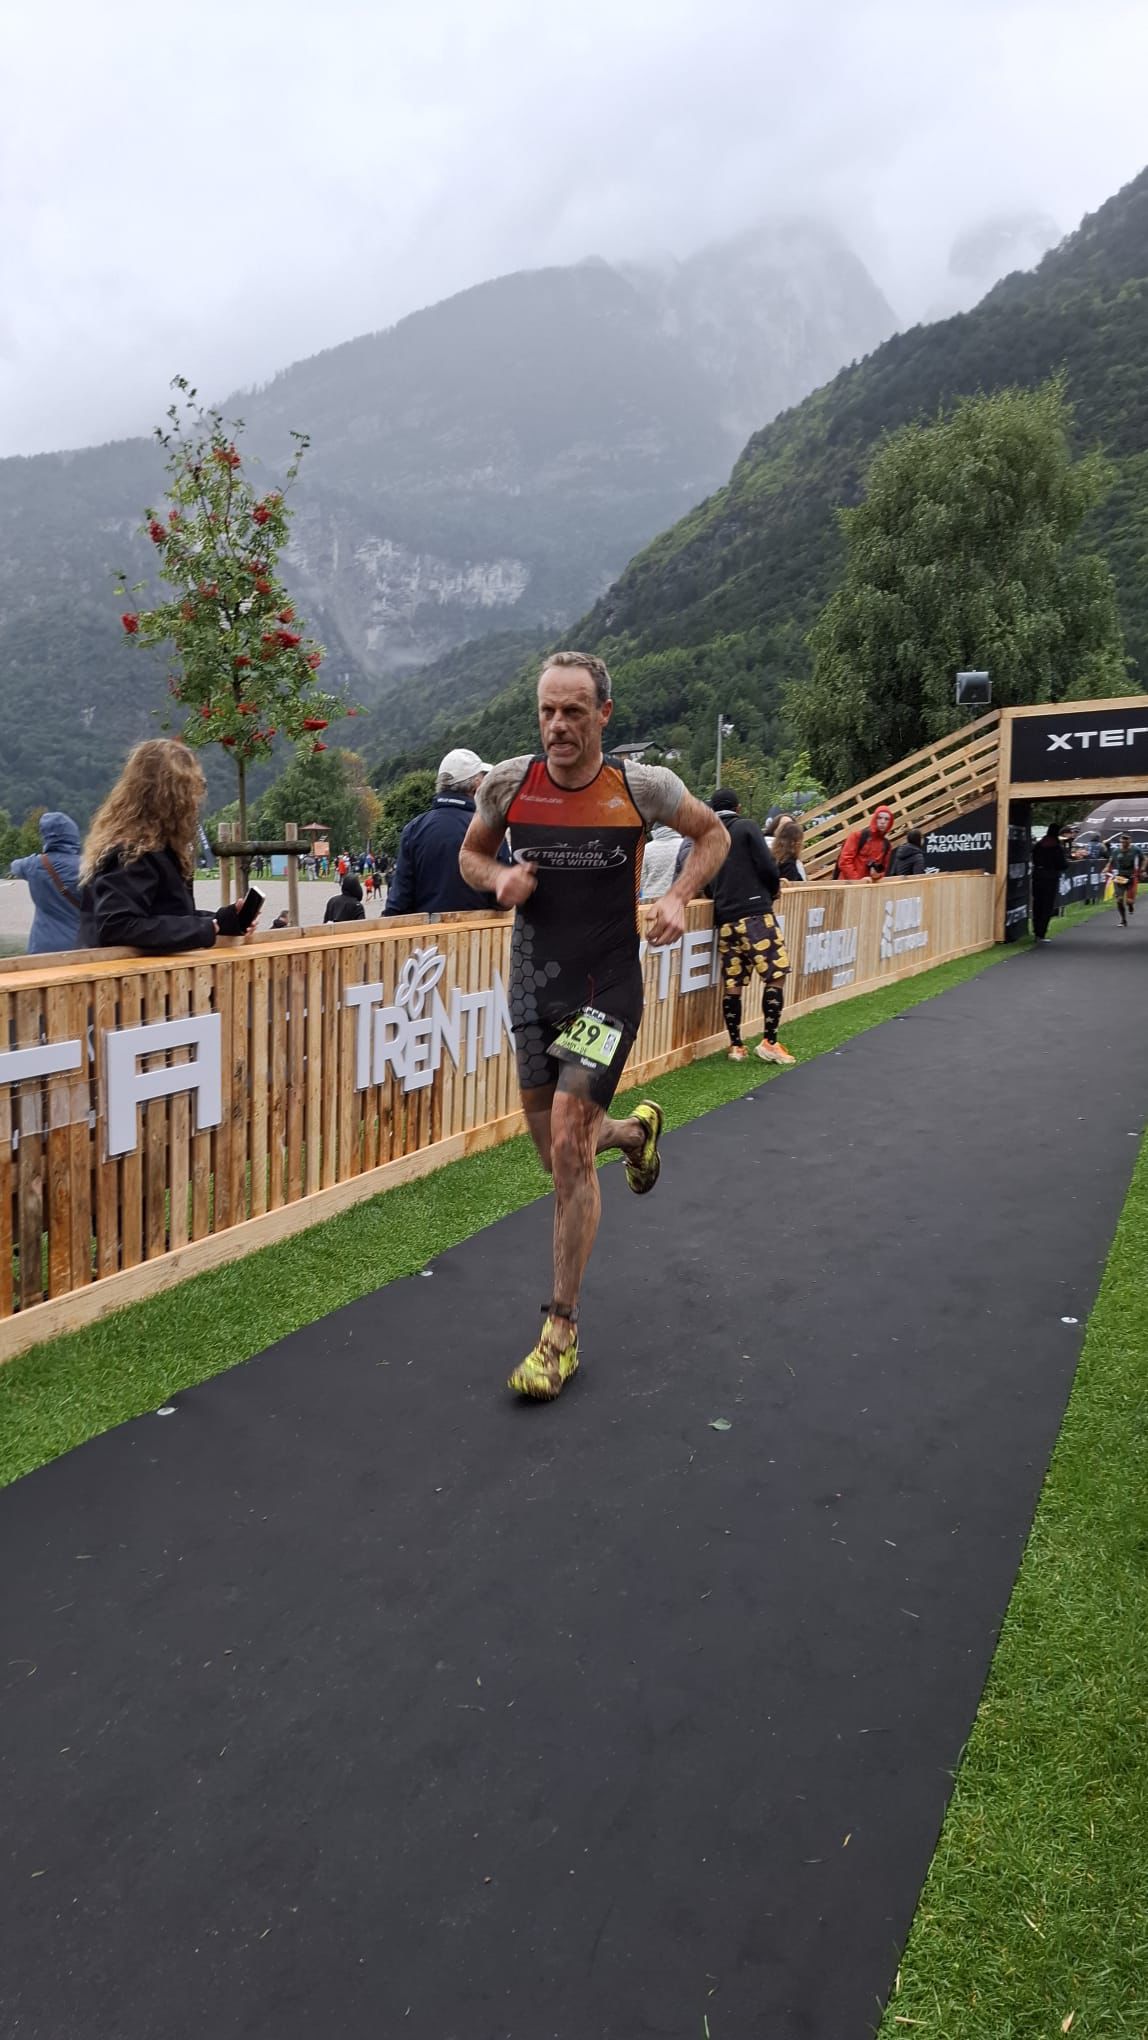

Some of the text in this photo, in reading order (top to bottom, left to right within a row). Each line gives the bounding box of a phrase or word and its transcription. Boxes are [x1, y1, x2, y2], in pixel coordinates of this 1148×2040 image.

[938, 832, 992, 844] DOLOMITI
[926, 841, 992, 853] PAGANELLA
[542, 851, 603, 859] TRIATHLON
[567, 859, 608, 867] WITTEN
